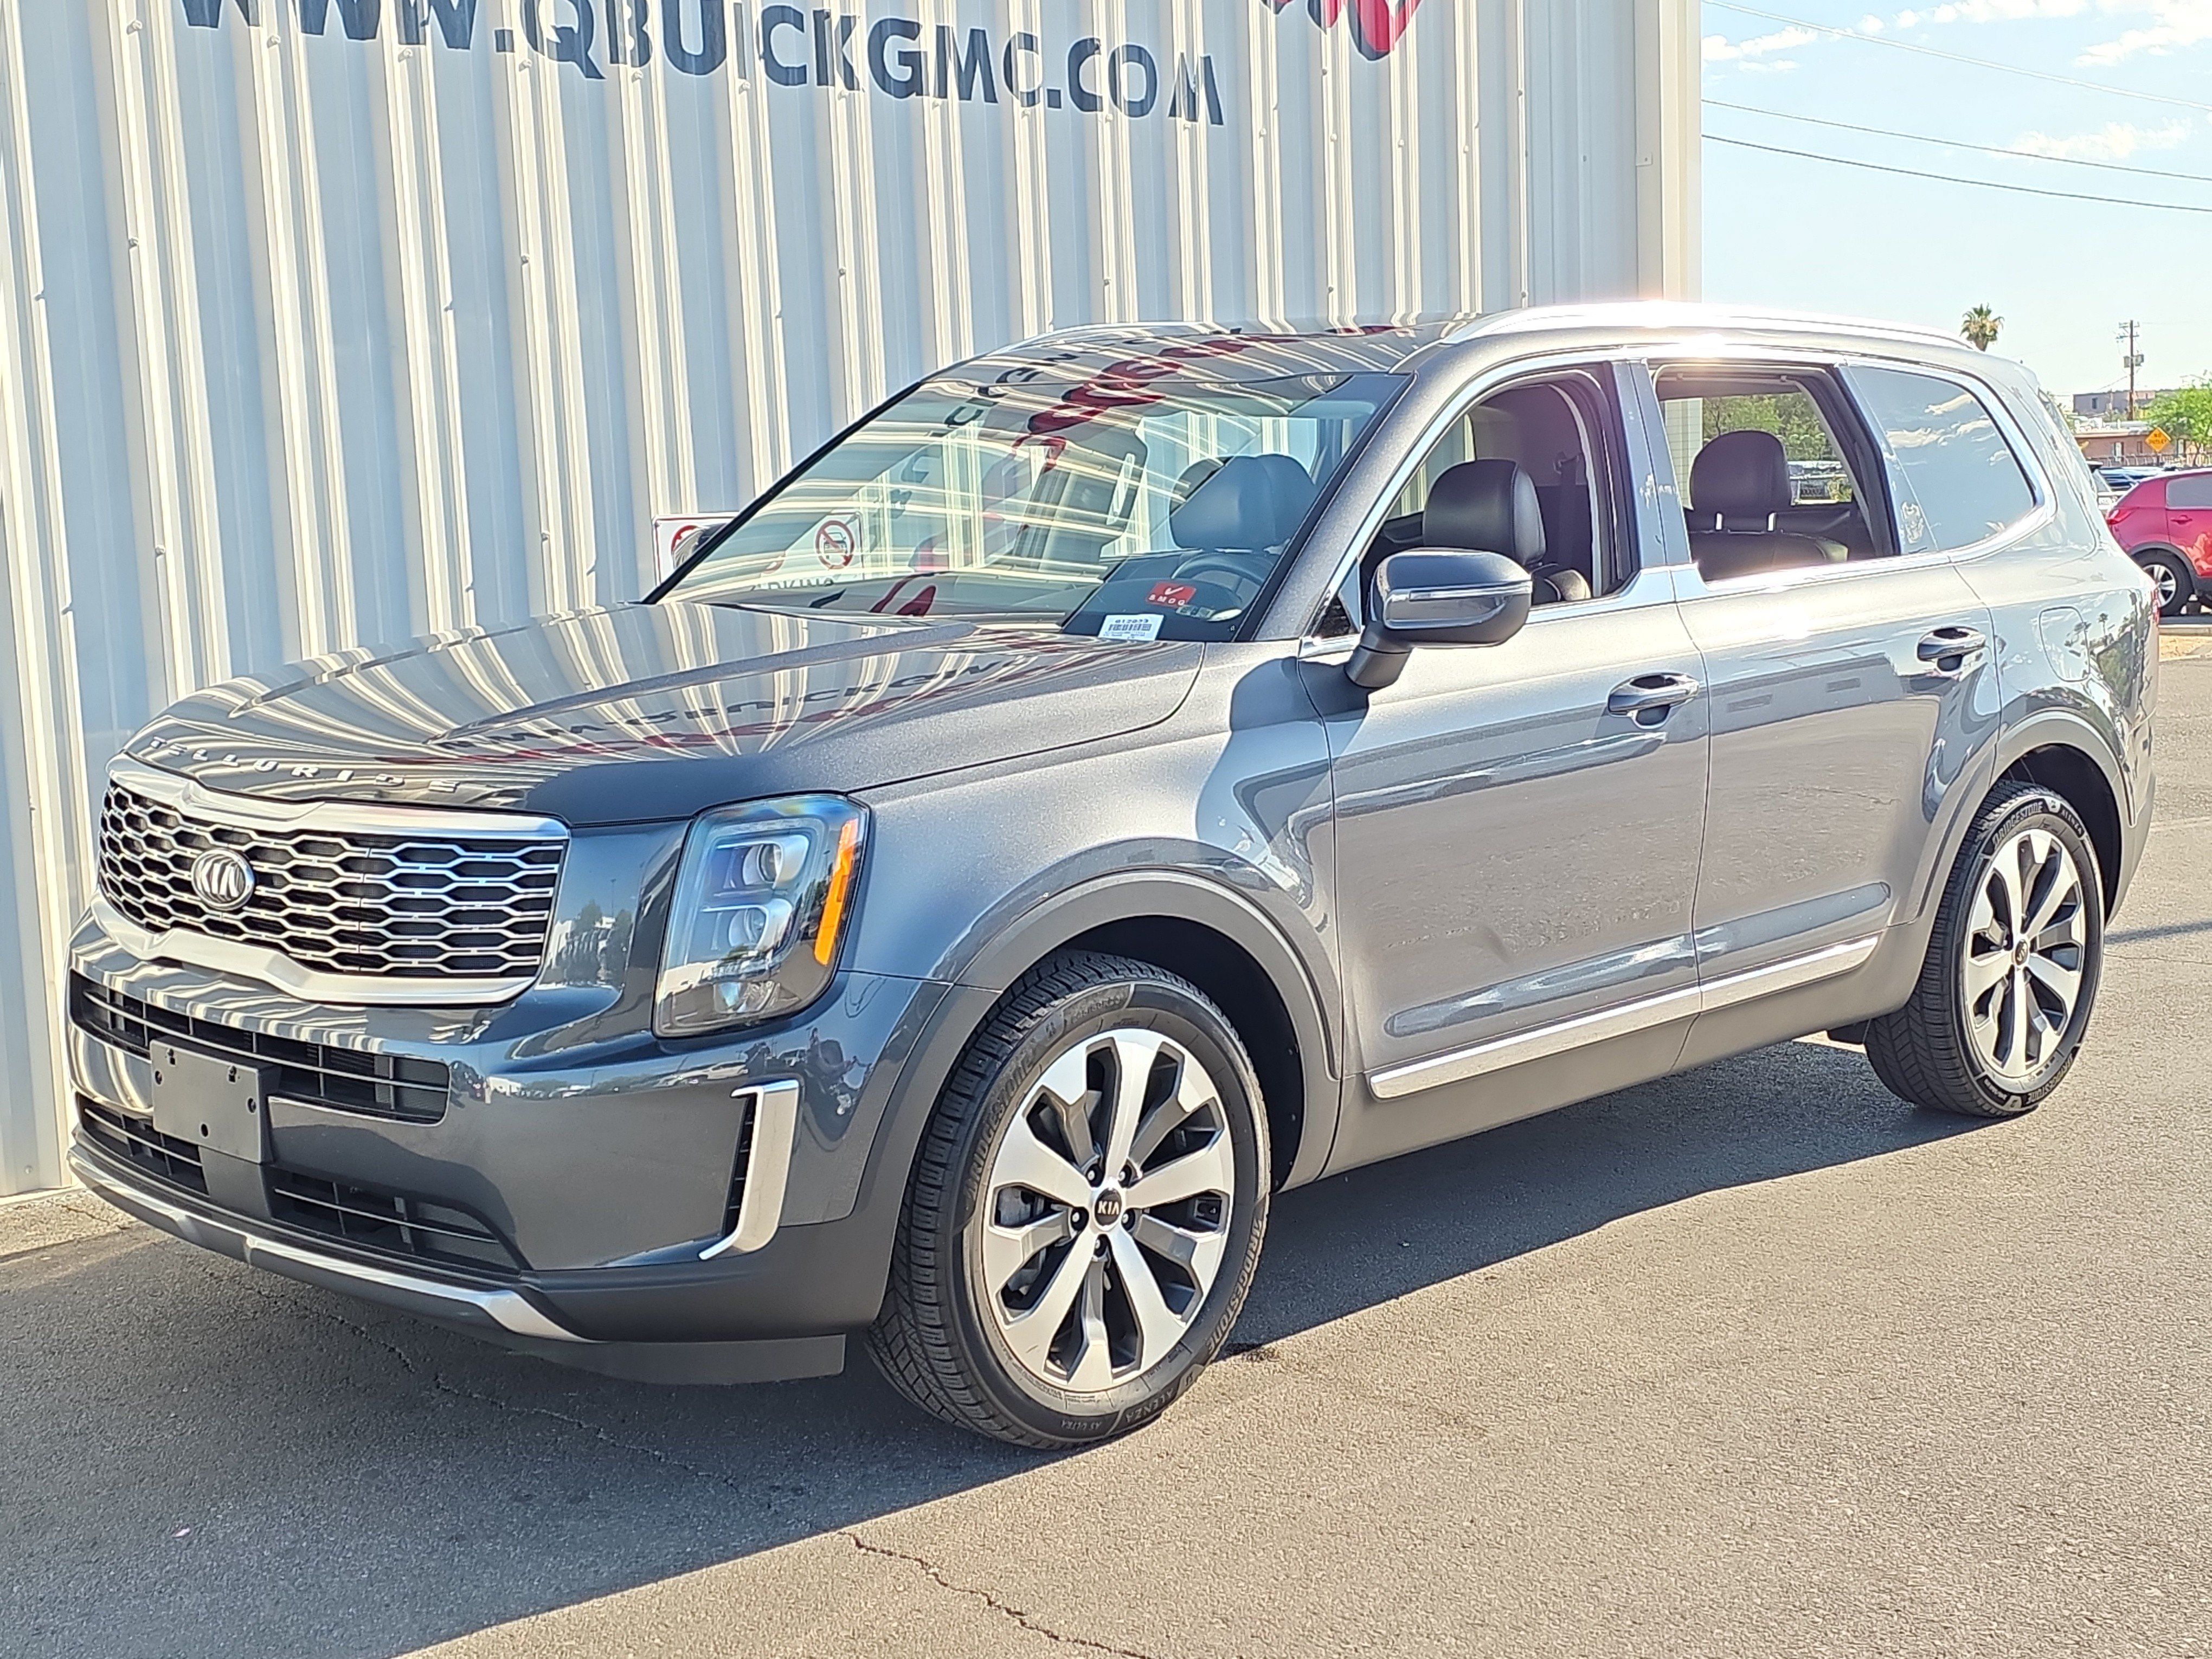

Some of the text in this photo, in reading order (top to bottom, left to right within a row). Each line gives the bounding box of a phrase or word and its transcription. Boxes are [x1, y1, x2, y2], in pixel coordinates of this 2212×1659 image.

[150, 736, 461, 793] TELLURIDE
[1097, 1200, 1119, 1215] KIA
[1206, 1219, 1262, 1352] BRIDGESTONE
[1125, 1388, 1174, 1423] ALENZA
